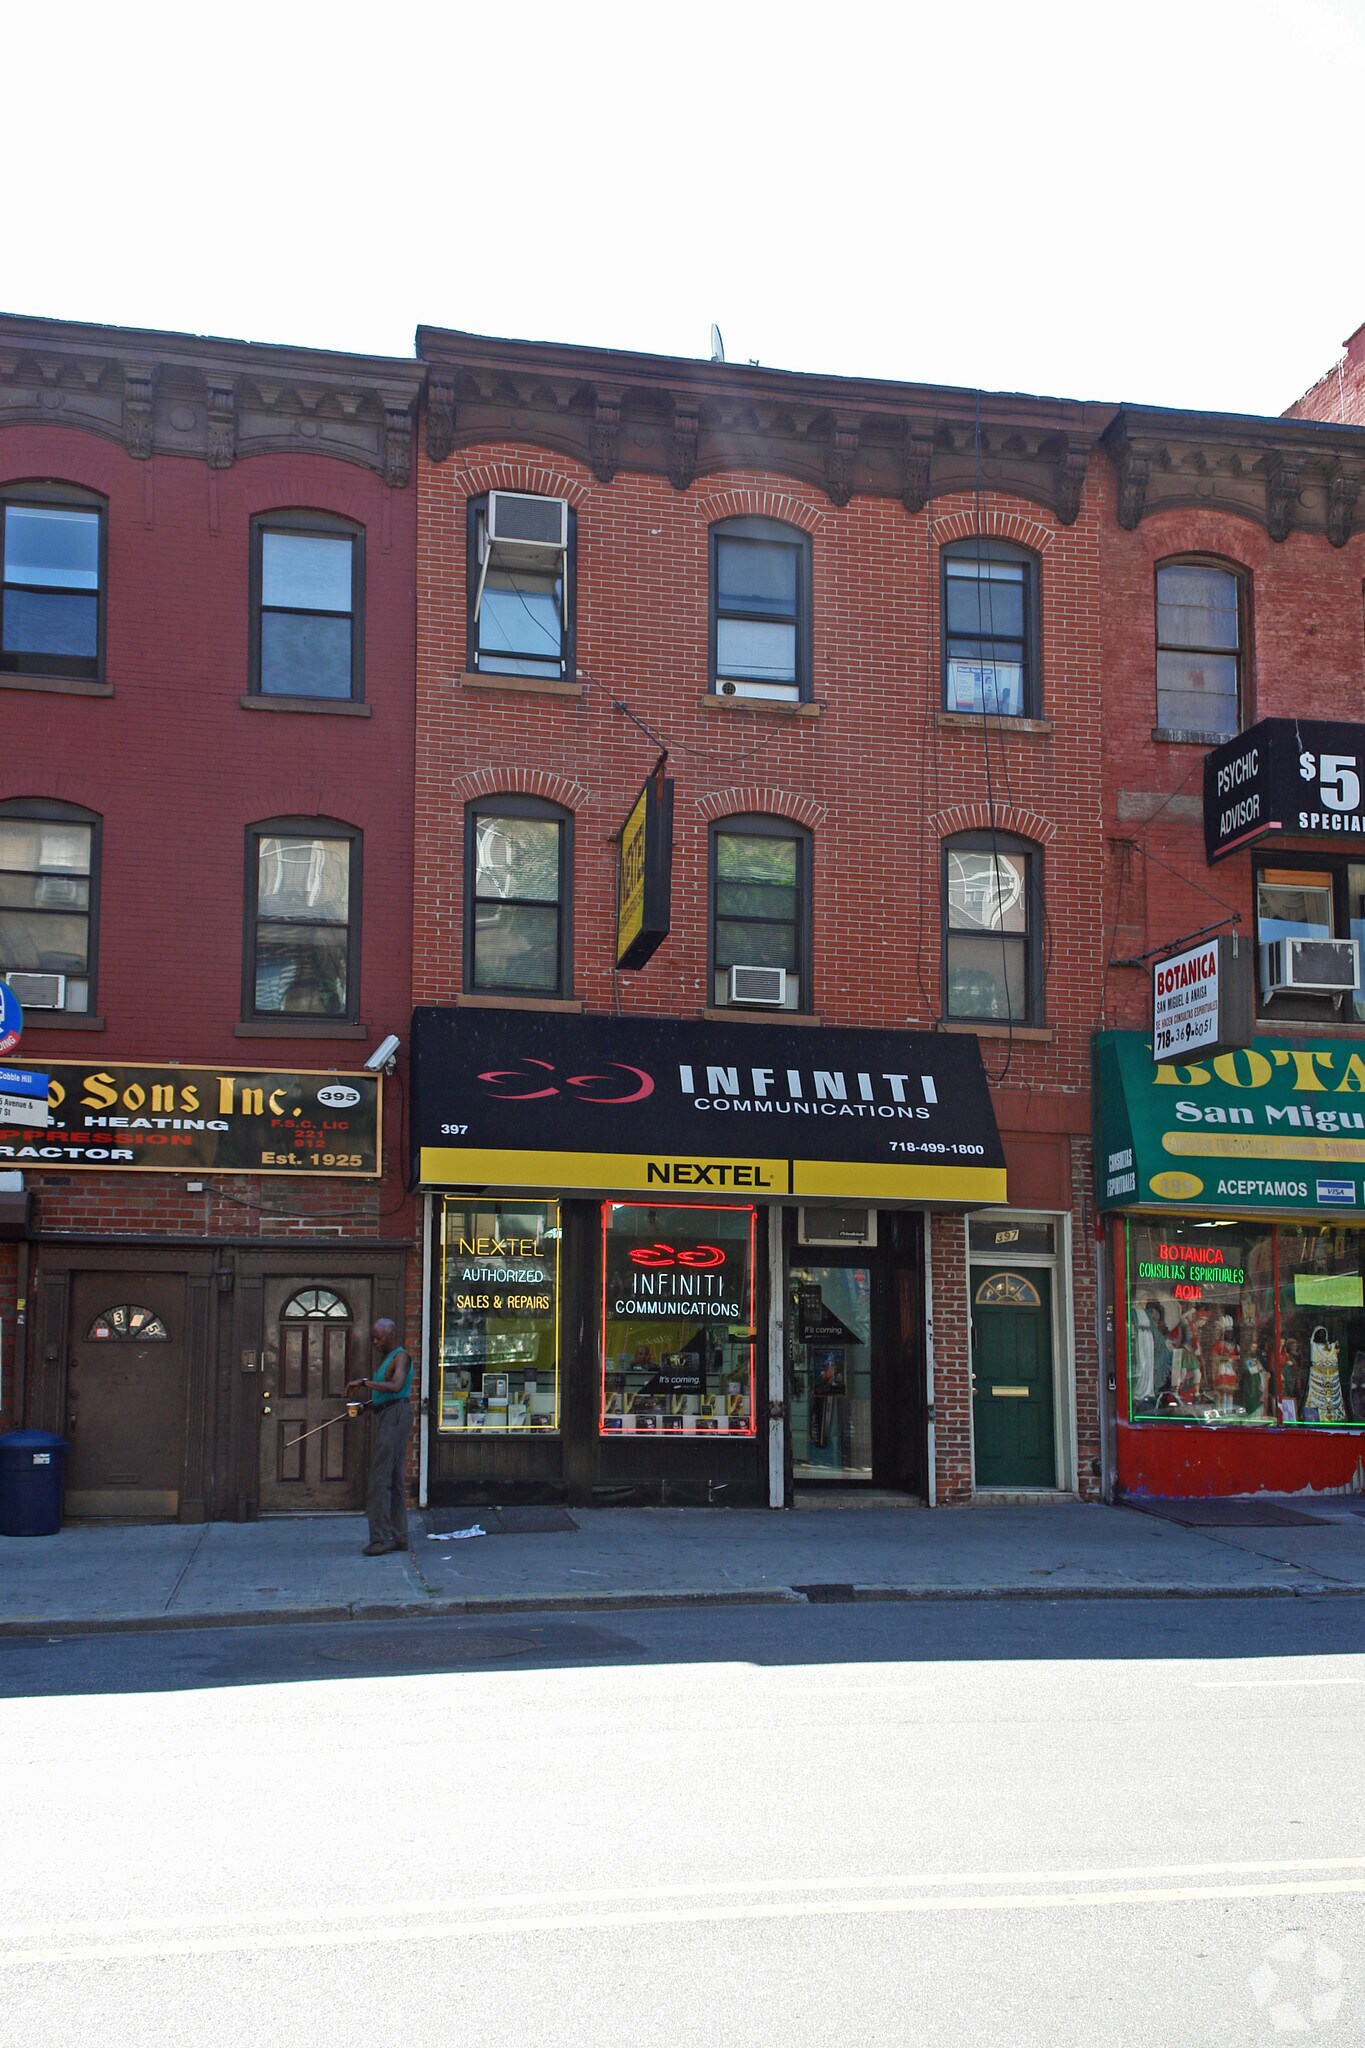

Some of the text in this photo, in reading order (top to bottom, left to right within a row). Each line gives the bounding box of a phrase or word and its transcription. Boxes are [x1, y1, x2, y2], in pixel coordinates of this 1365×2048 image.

[1217, 749, 1259, 797] PSYCHIC
[1219, 794, 1260, 837] ADVISOR
[1299, 812, 1365, 832] SPECIA
[1157, 951, 1216, 996] BOTANICA
[1157, 1000, 1166, 1014] SAN
[1167, 994, 1184, 1010] MIGUEL
[0, 1071, 32, 1084] Cobble Hill
[679, 1064, 938, 1104] INFINITI
[80, 1072, 200, 1113] Sons
[216, 1077, 302, 1117] Inc.
[320, 1091, 358, 1101] 395
[4, 1099, 26, 1109] Avenue
[28, 1102, 33, 1110] &
[4, 1109, 11, 1117] St
[694, 1098, 931, 1120] COMMUNICATIONS
[84, 1116, 229, 1131] HEATING
[323, 1120, 349, 1130] LIC
[1175, 1101, 1365, 1132] San Migu
[294, 1130, 324, 1138] 221
[440, 1124, 469, 1135] 397
[889, 1141, 985, 1155] 718-499-1800
[261, 1152, 363, 1166] Est. 1925
[647, 1162, 771, 1187] NEXTEL
[1159, 1178, 1193, 1195] 399
[1217, 1179, 1308, 1197] ACEPTAMOS
[1327, 1188, 1345, 1196] VISA
[459, 1237, 545, 1257] NEXTEL
[1159, 1244, 1224, 1264] BOTANICA
[462, 1268, 544, 1283] AUTHORIZED
[1139, 1262, 1244, 1284] CONSULTAS ESPIRITUALES
[633, 1273, 723, 1296] INFINITI
[456, 1295, 550, 1310] SALES & REPAIRS
[615, 1300, 739, 1317] COMMUNICATIONS
